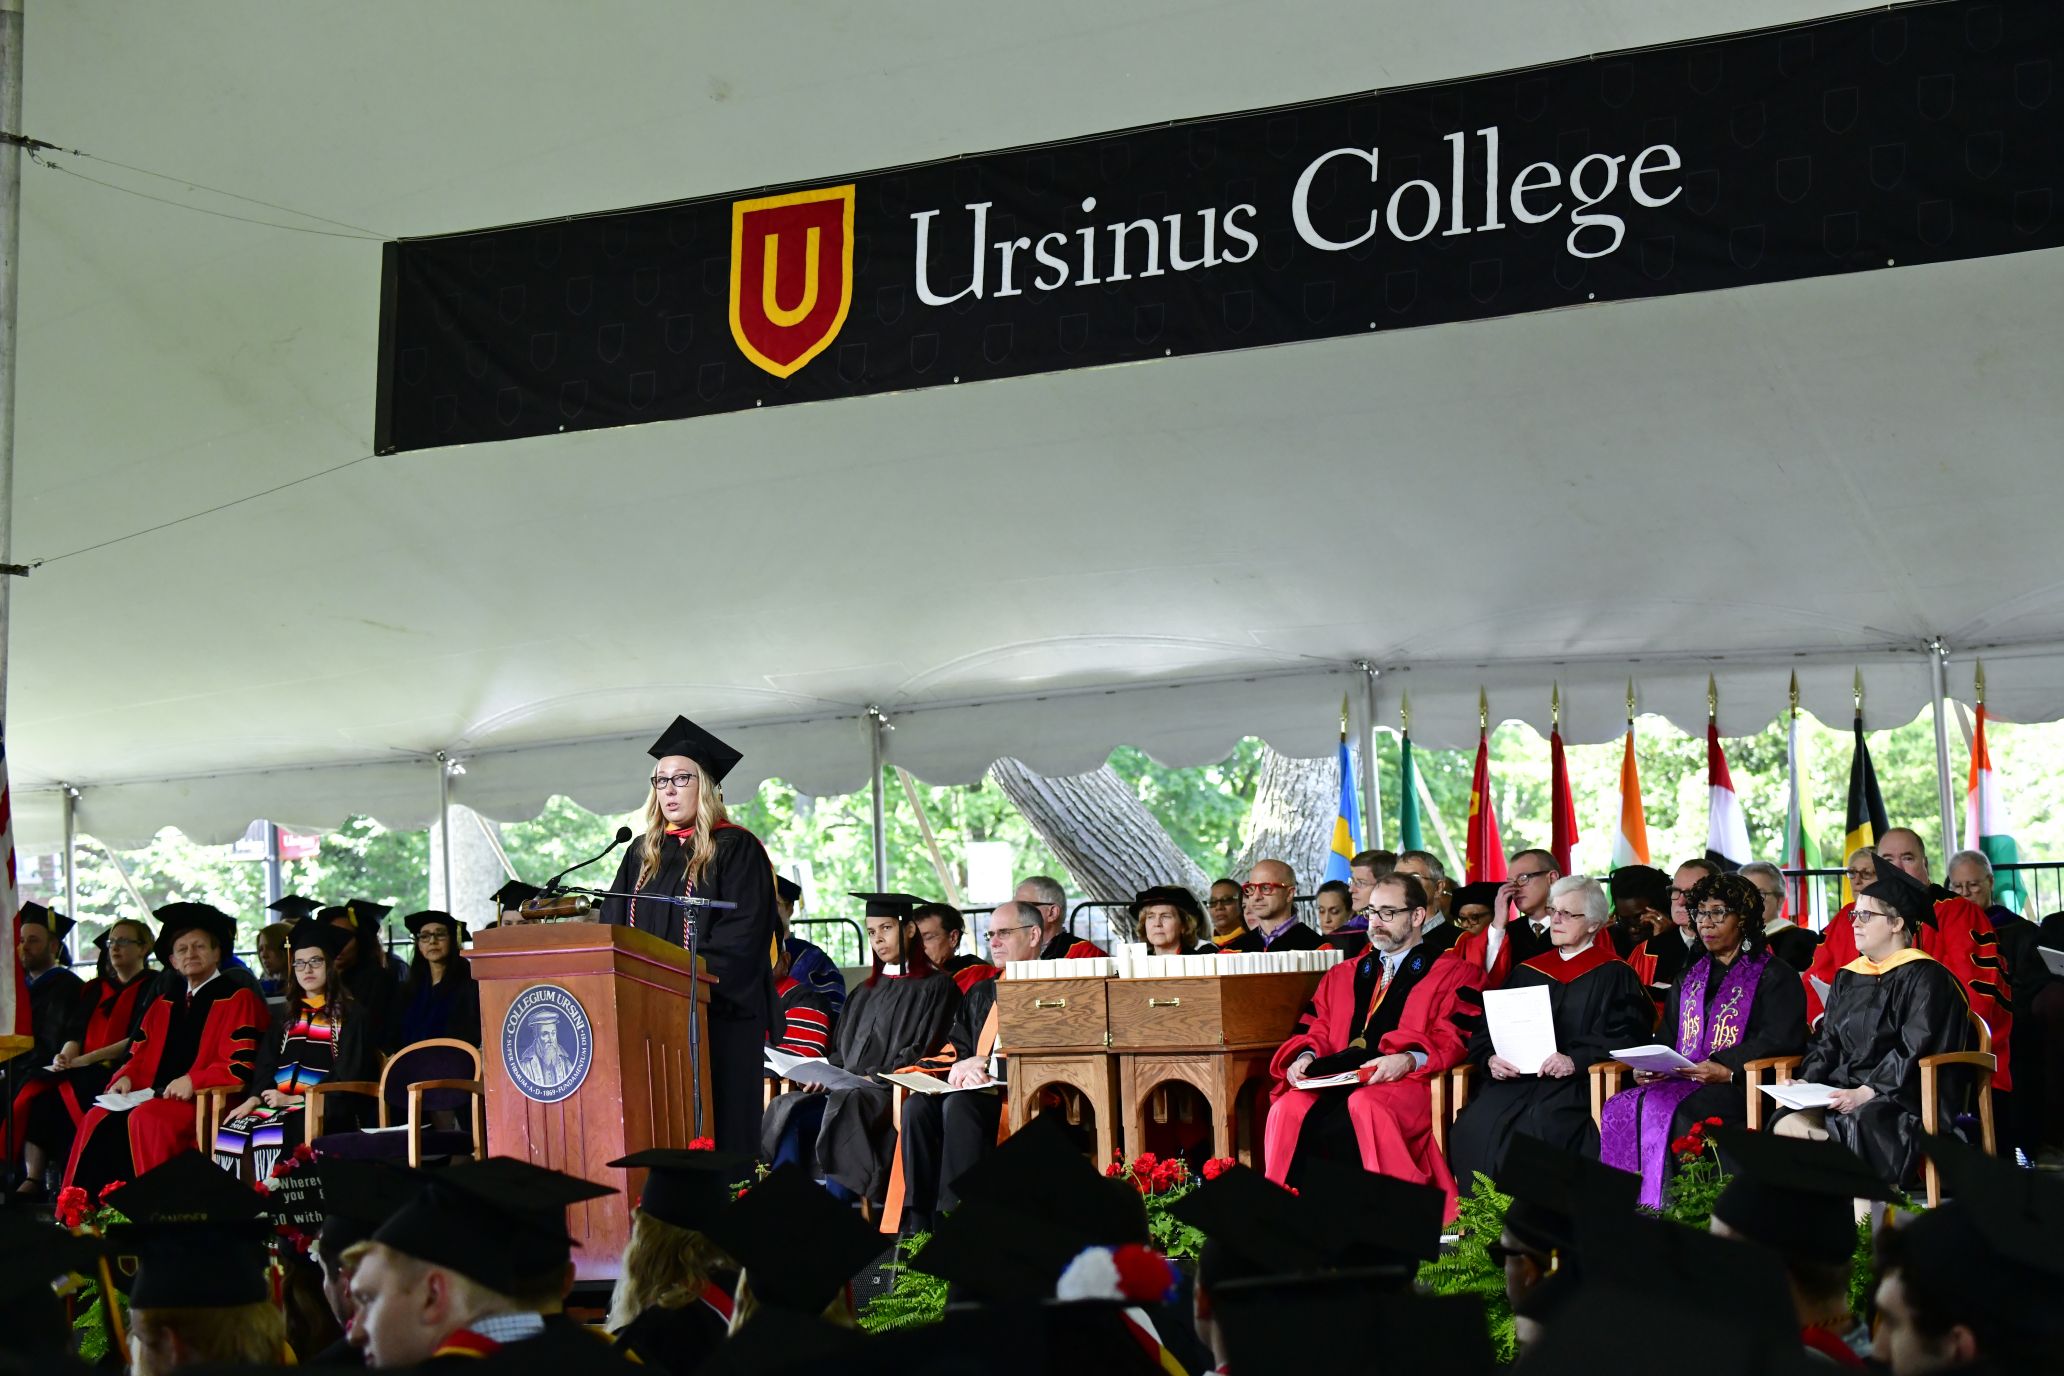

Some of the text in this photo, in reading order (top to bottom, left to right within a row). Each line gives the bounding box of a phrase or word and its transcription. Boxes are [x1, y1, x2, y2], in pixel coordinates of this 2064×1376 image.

[910, 127, 1683, 306] Ursinus College
[762, 226, 821, 328] U
[506, 990, 585, 1034] COLLEGIUM URSINI
[558, 1047, 587, 1093] FUNDAMENTUM
[283, 1191, 305, 1204] you
[293, 1210, 324, 1224] with
